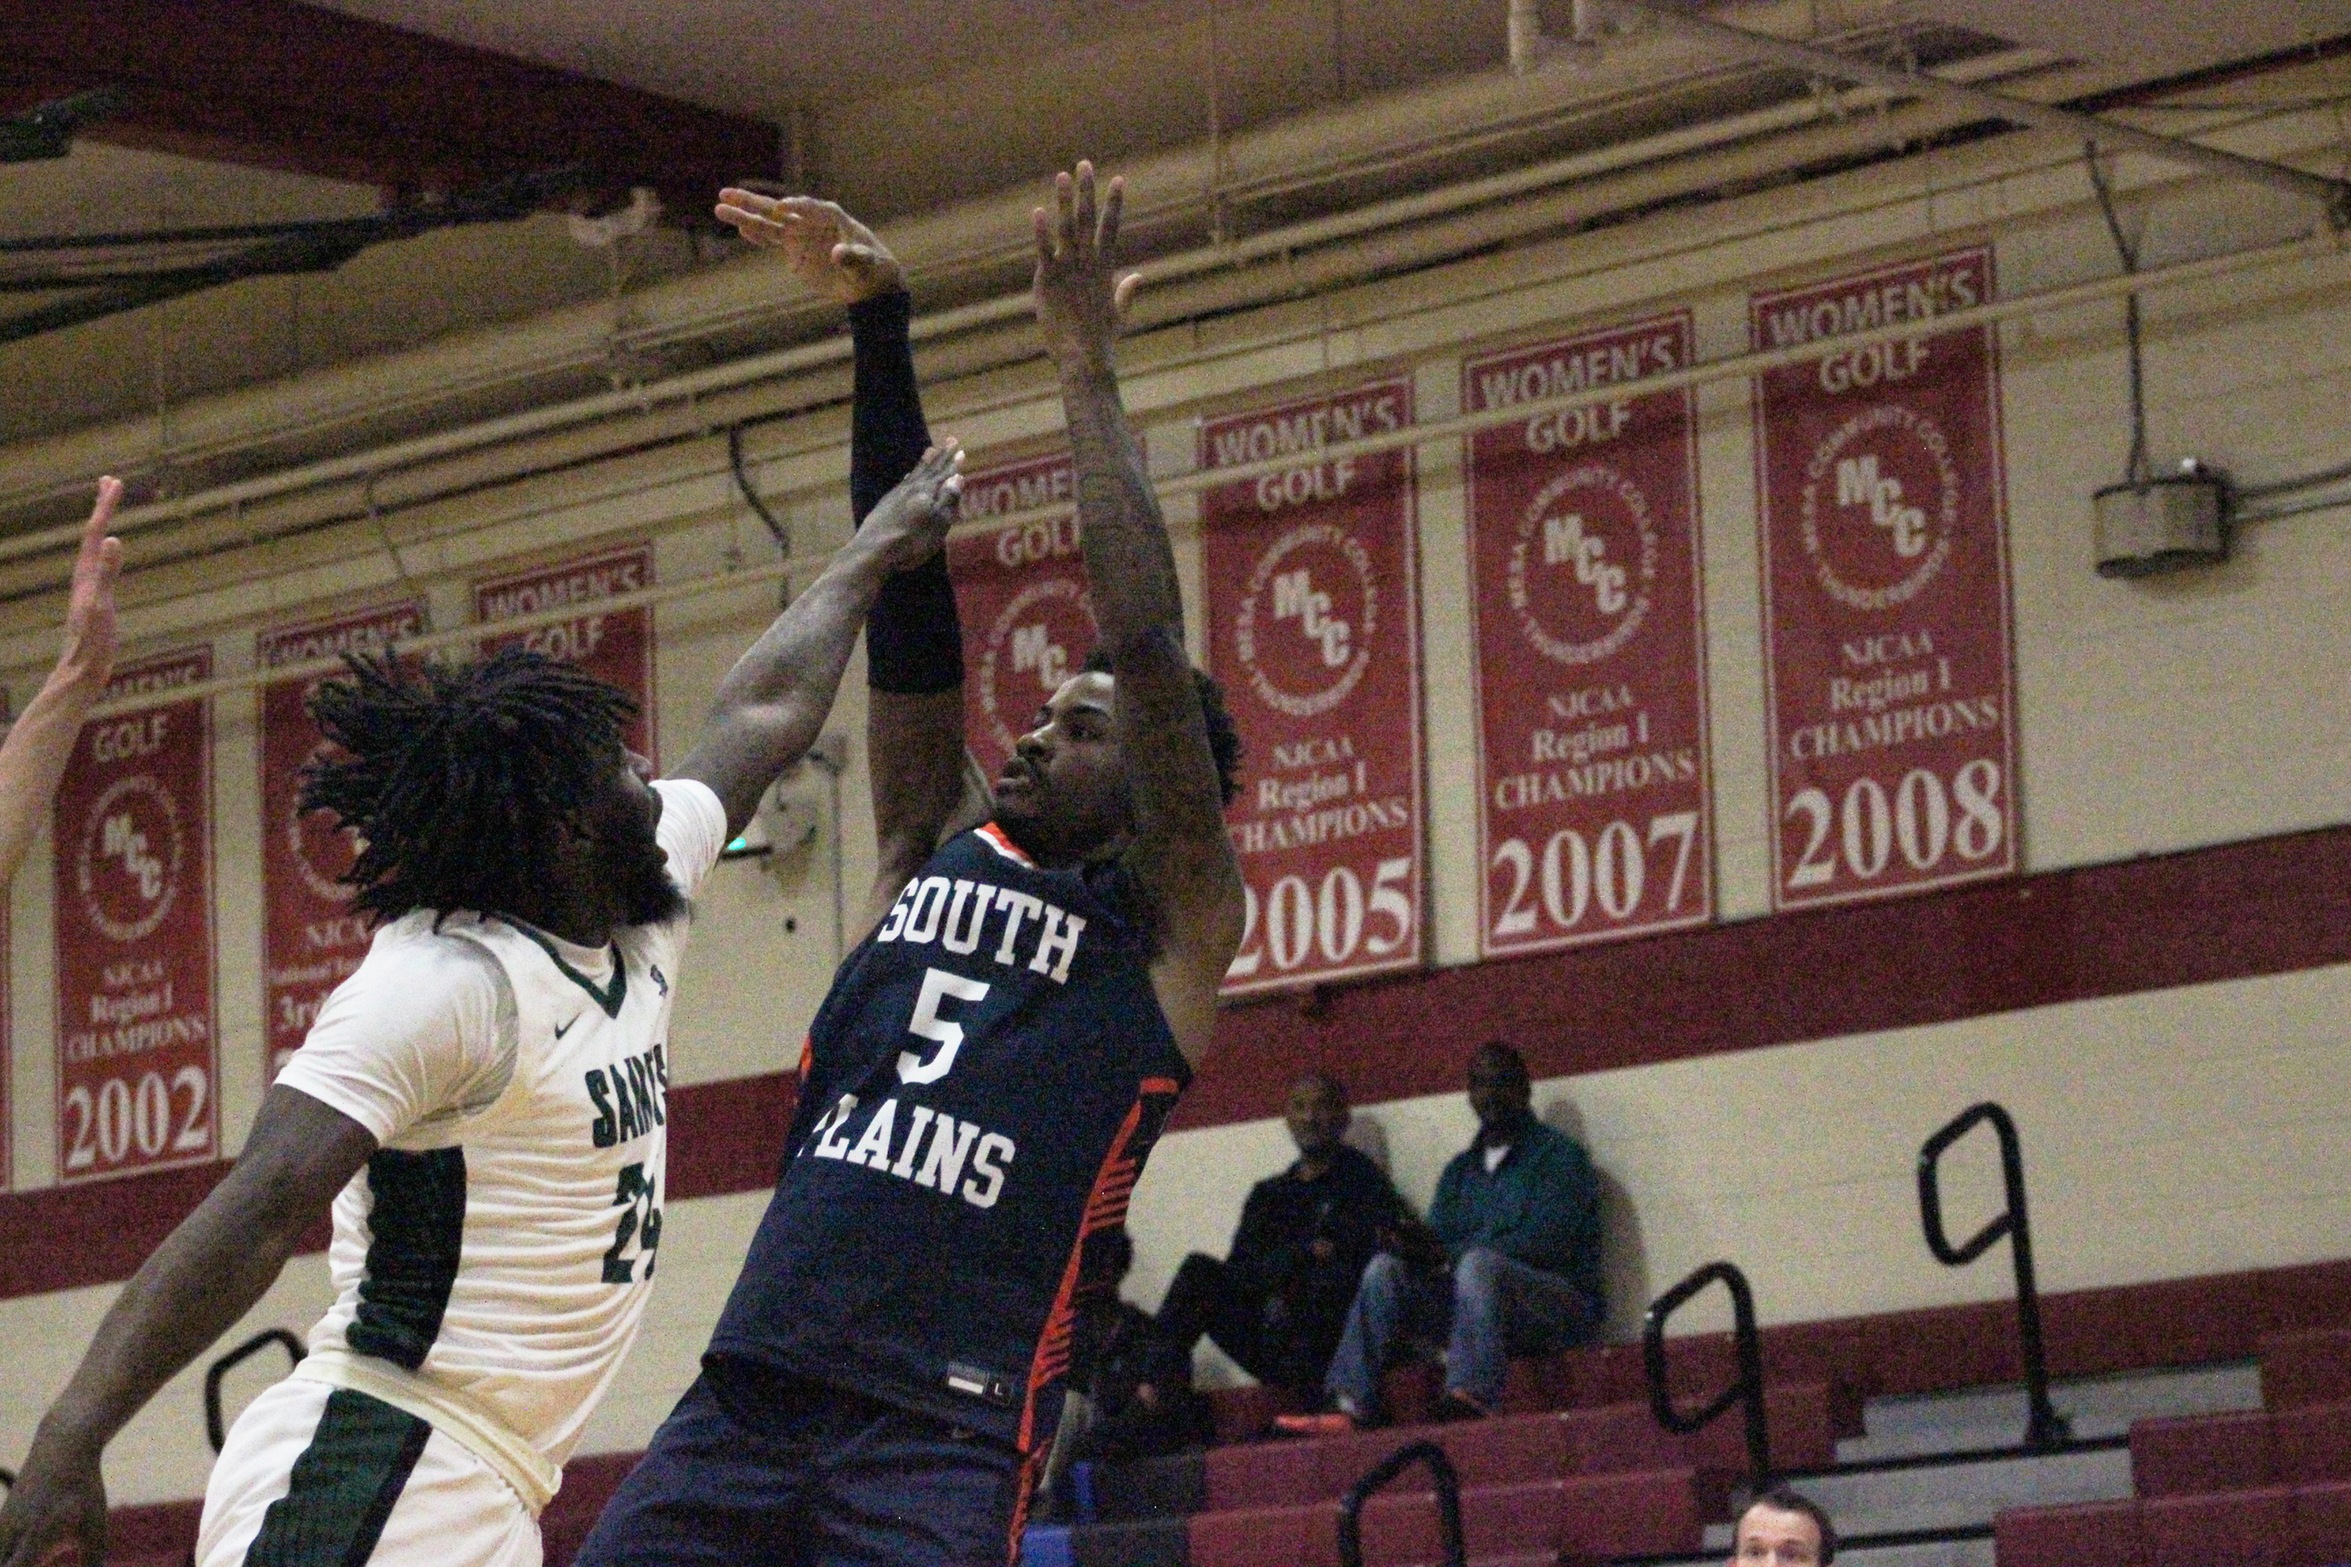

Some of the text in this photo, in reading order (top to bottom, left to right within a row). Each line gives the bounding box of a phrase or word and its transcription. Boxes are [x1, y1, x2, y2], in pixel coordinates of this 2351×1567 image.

[1770, 269, 1977, 343] WOMEN'S
[1480, 335, 1675, 410] WOMEN'S
[1821, 338, 1928, 392] GOLF
[1214, 397, 1397, 466] WOMEN'S
[1526, 398, 1632, 454] GOLF
[1256, 454, 1355, 511] GOLF
[1837, 453, 1926, 557] MCC
[1544, 513, 1627, 614] MCC
[1272, 569, 1348, 666] MCC
[1790, 693, 1998, 759] CHAMPIONS
[1831, 668, 1929, 712] Region
[94, 713, 167, 763] GOLF
[1532, 720, 1630, 763] Region
[1256, 772, 1349, 811] Region
[1495, 748, 1695, 810] CHAMPIONS
[104, 813, 162, 899] MCC
[1784, 758, 2001, 888] 2008
[1492, 811, 1700, 936] 2007
[878, 876, 1086, 985] SOUTH
[67, 1014, 206, 1062] CHAMPIONS
[896, 967, 990, 1085] 5
[66, 1066, 208, 1169] 2002
[797, 1093, 1015, 1208] LAINS
